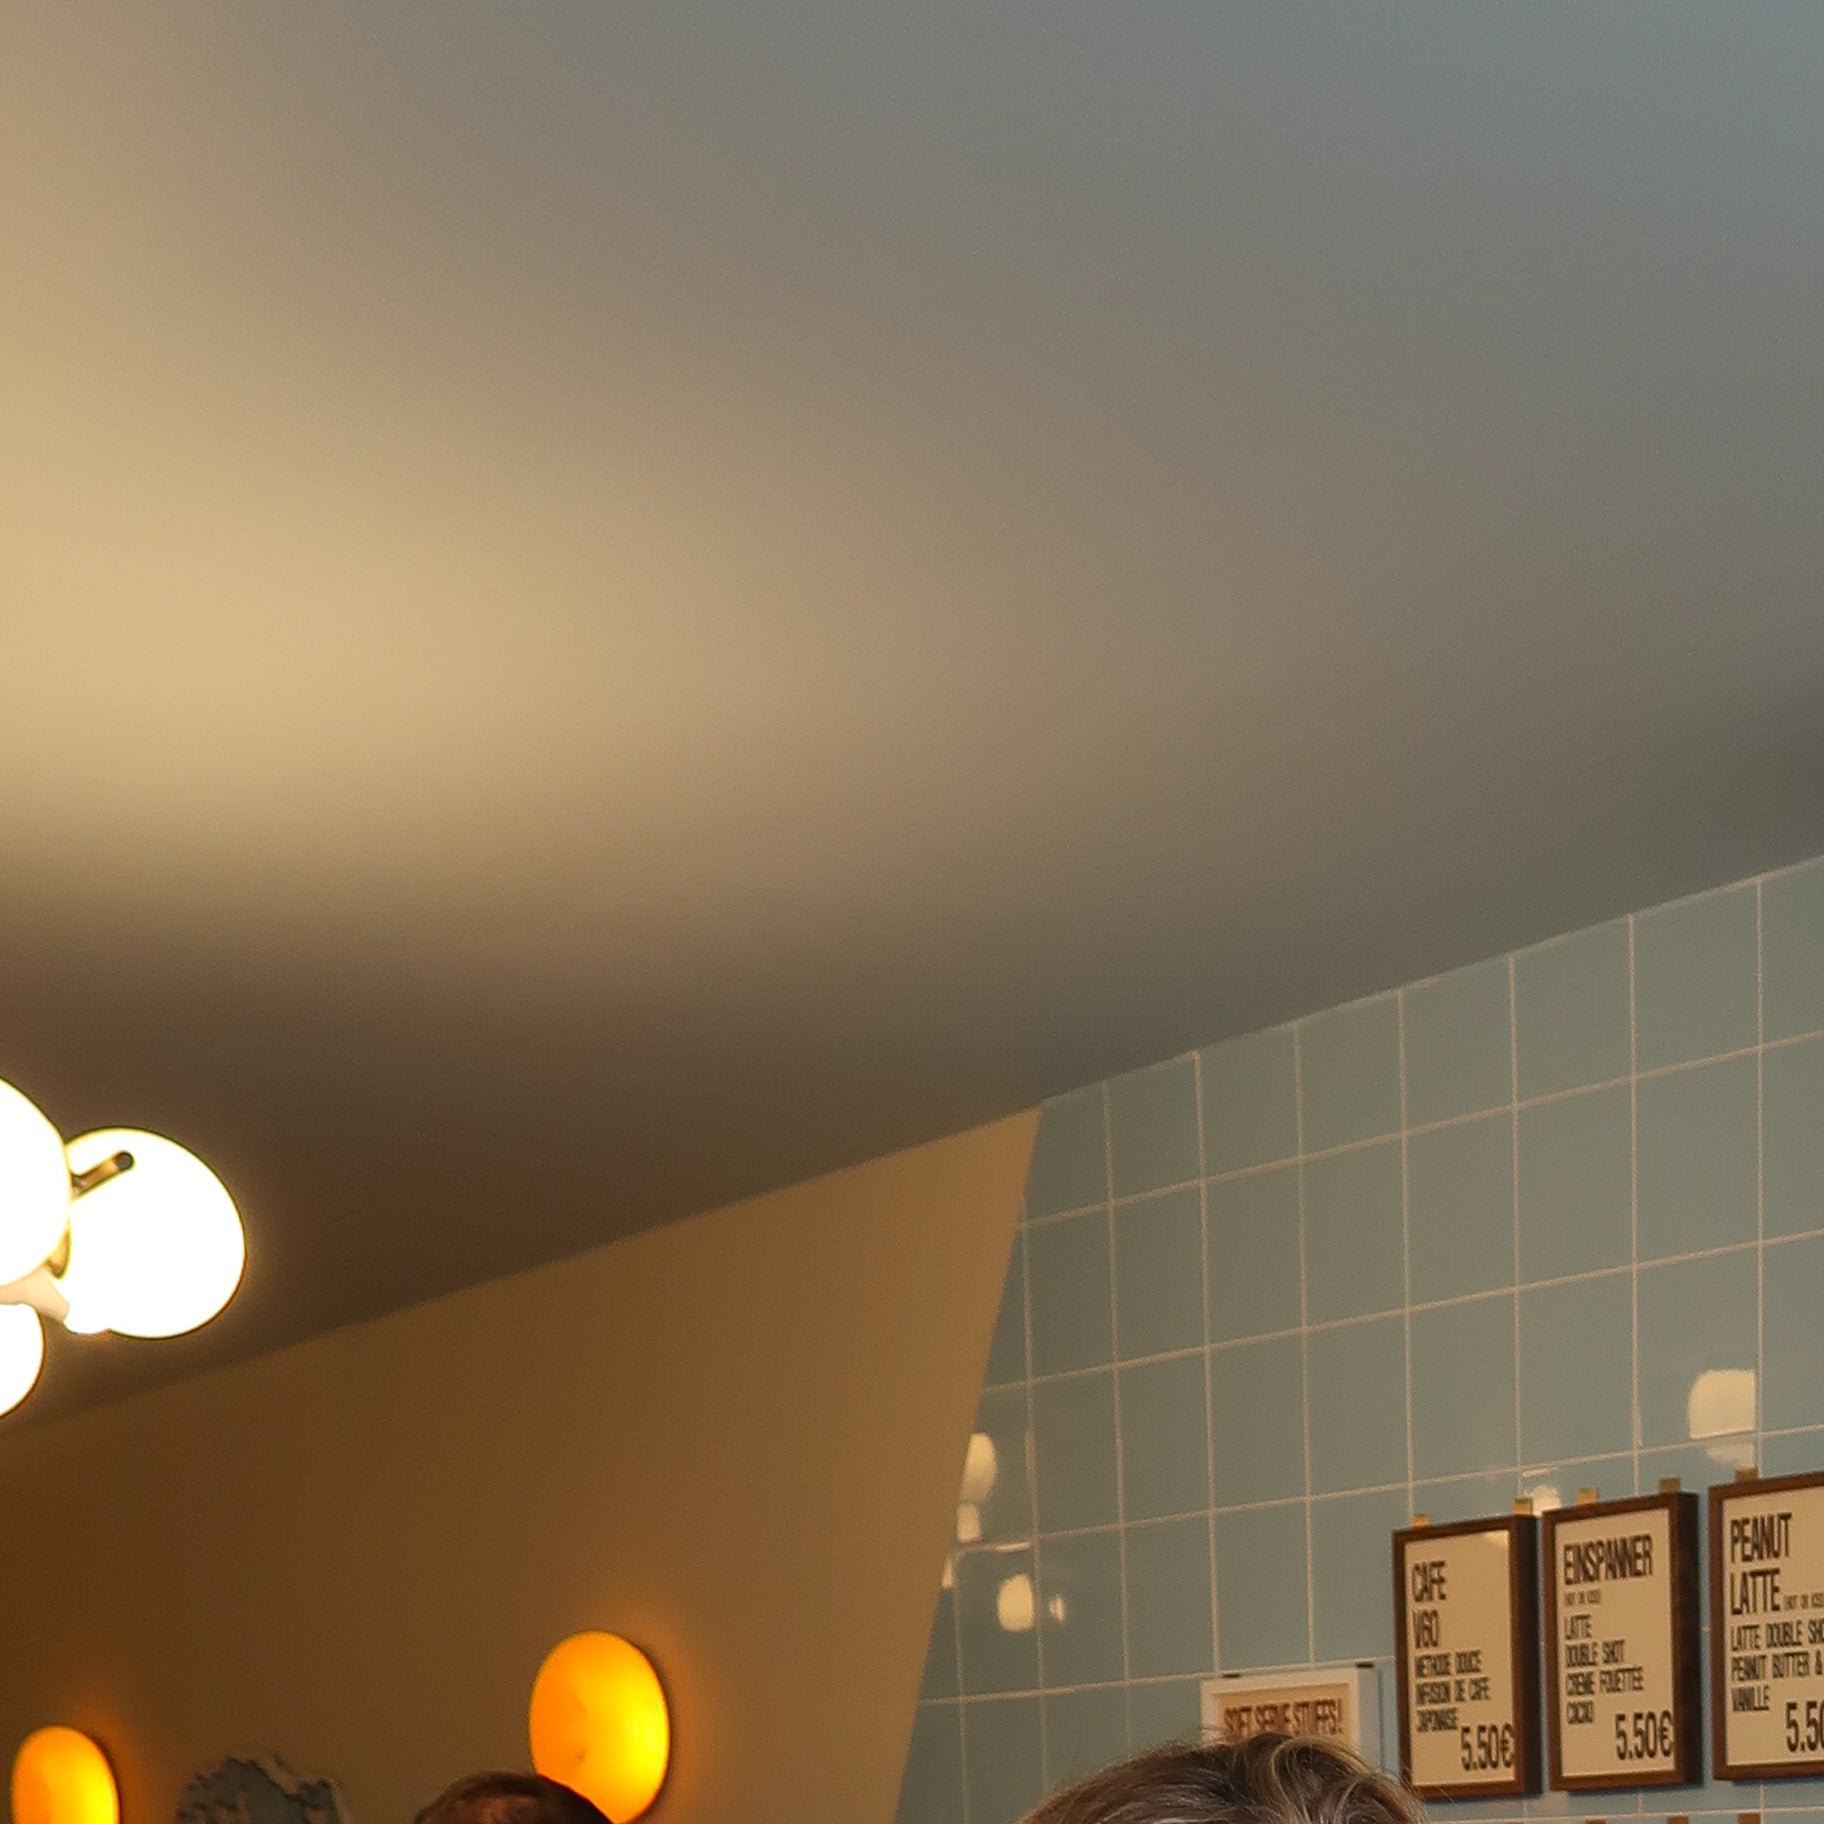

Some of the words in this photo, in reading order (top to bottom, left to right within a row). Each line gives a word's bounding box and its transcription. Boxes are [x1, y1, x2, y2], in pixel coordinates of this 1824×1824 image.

[1563, 1533, 1653, 1585] EINSPANNER
[1730, 1512, 1793, 1564] PEANUT
[1730, 1568, 1781, 1615] LATTE
[1564, 1614, 1592, 1641] LATTE
[1731, 1624, 1761, 1652] LATTE
[1765, 1621, 1802, 1648] DOUBLE
[1731, 1655, 1767, 1682] PEANUT
[1772, 1651, 1810, 1680] BUTTER
[1461, 1722, 1513, 1771] 5.50€
[1615, 1710, 1674, 1760] 5.50€
